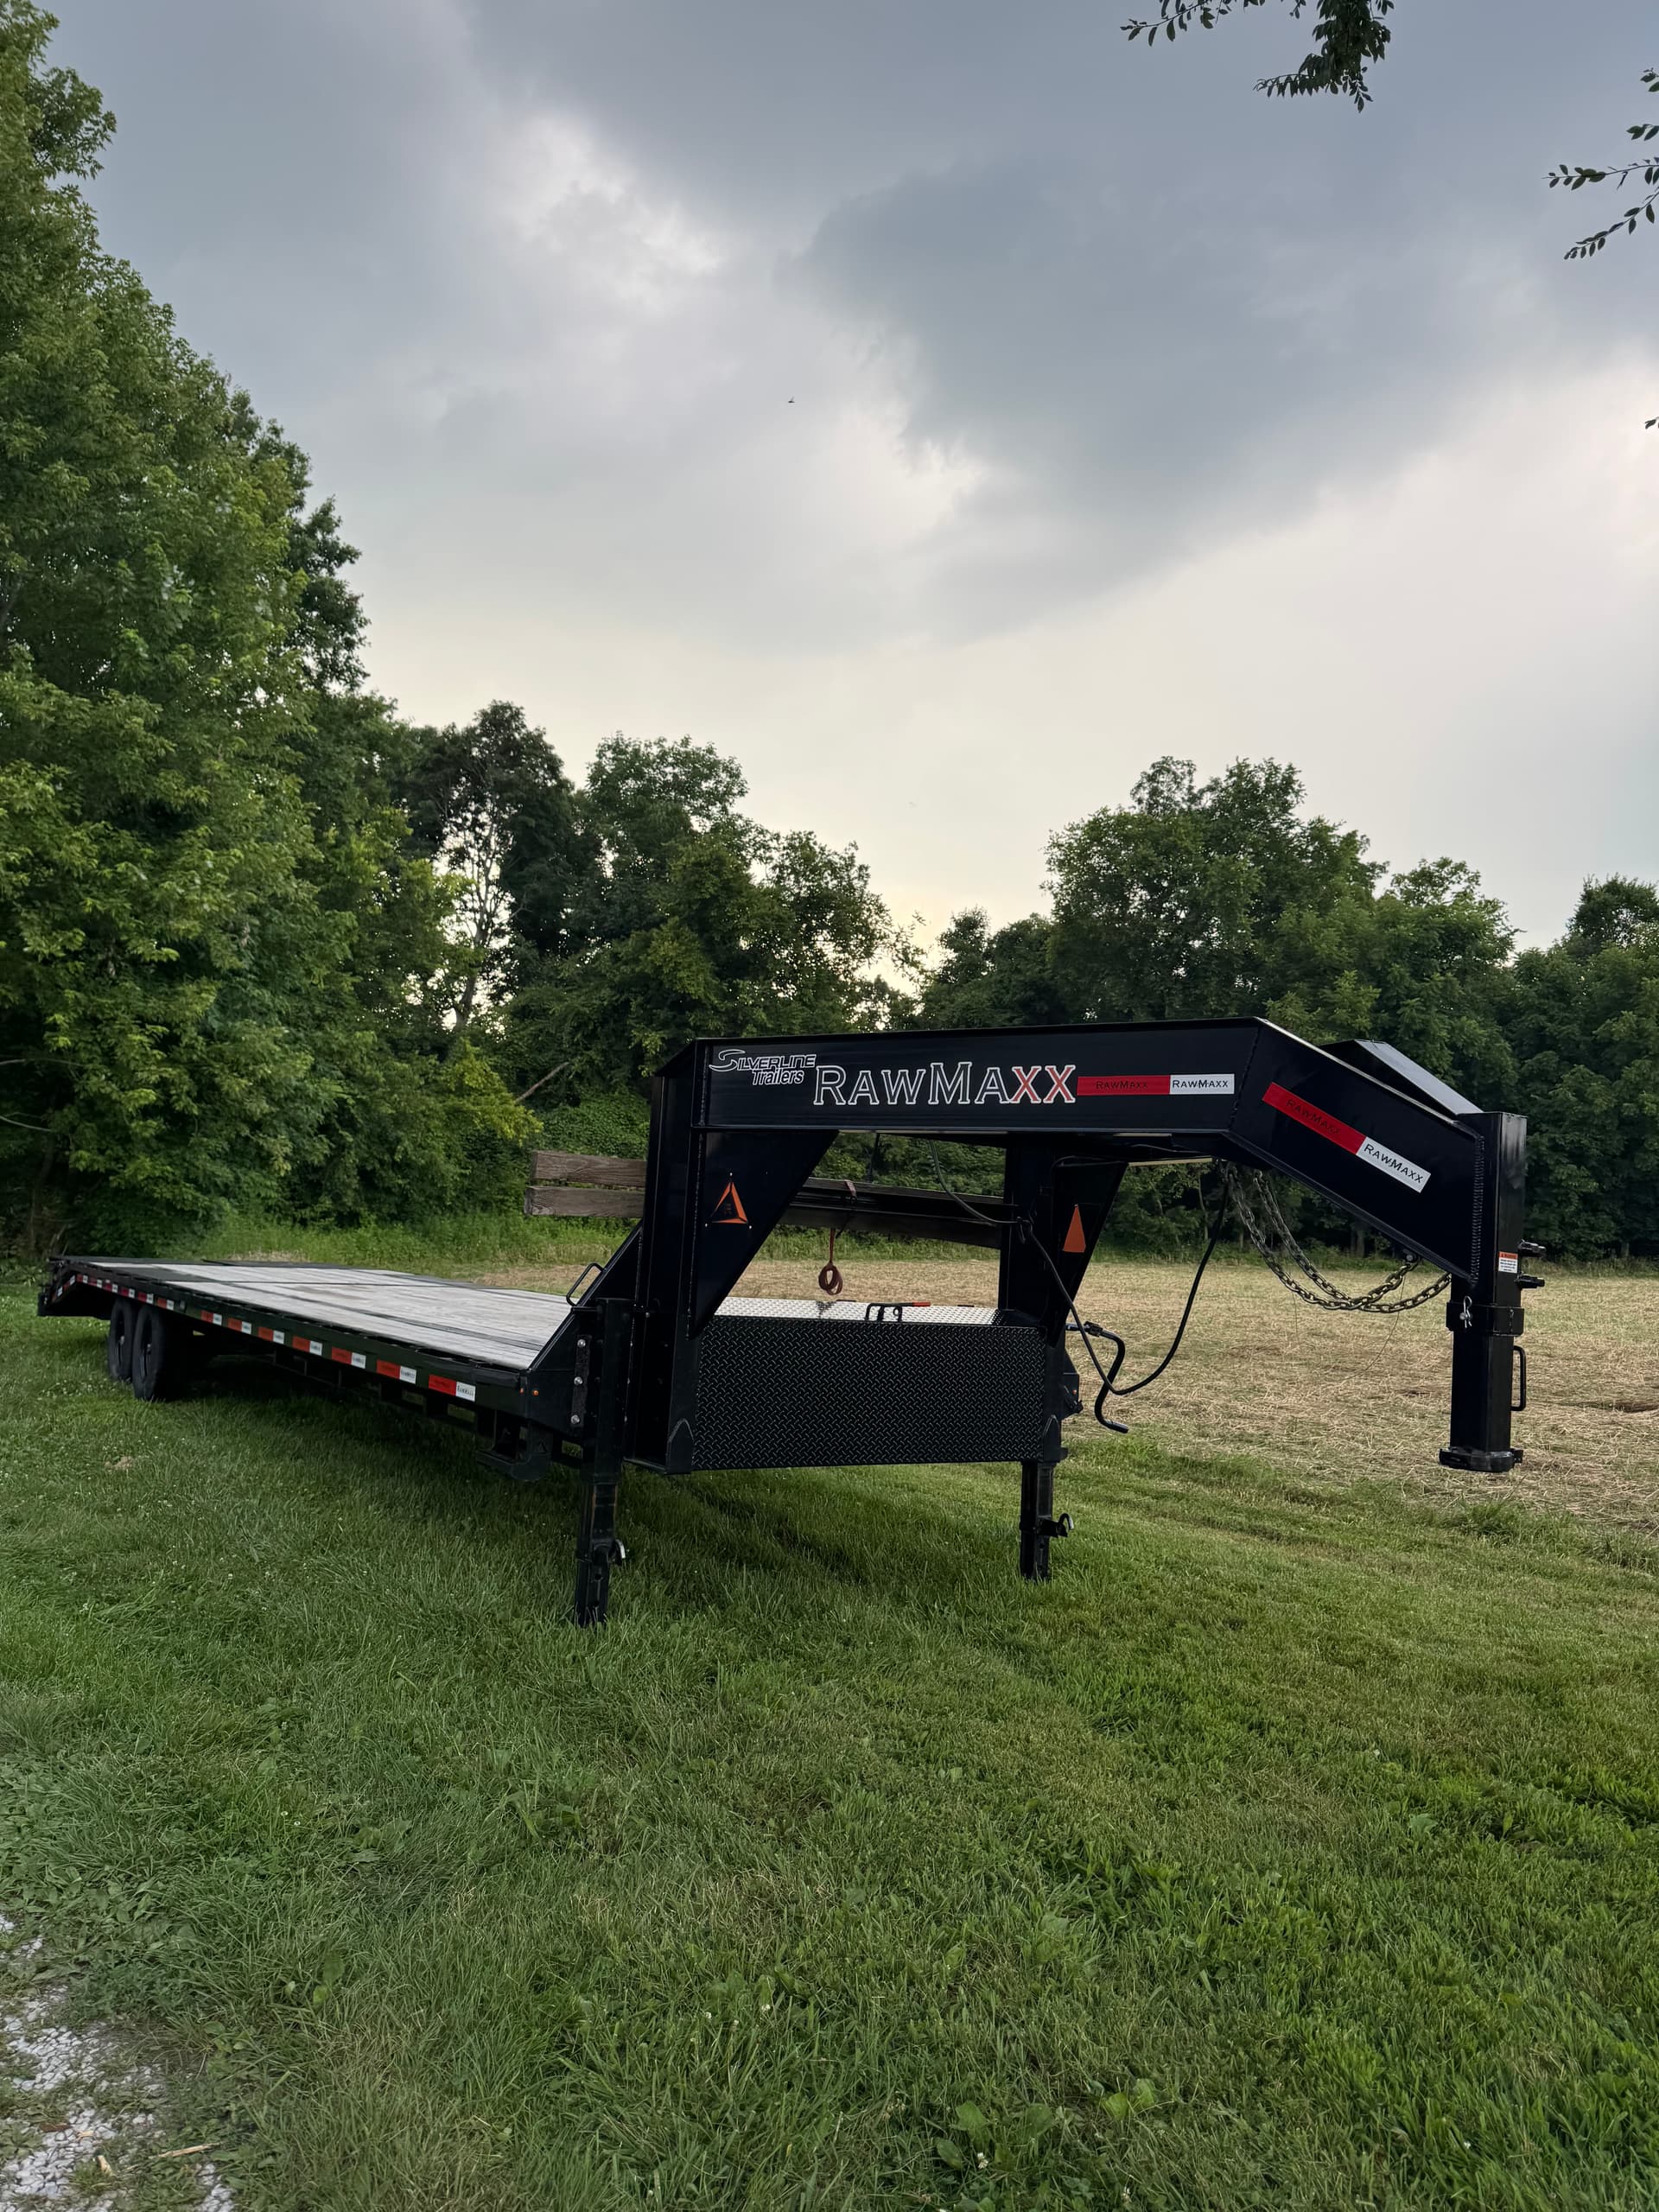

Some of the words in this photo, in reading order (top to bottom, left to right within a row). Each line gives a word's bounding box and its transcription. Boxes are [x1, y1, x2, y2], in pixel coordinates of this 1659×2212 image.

[709, 1048, 817, 1072] SILVERLINE
[752, 1068, 804, 1085] Trailers
[813, 1061, 1076, 1105] RAWMAXX
[1172, 1079, 1229, 1089] RAWMAXX
[1363, 1143, 1424, 1184] RAWMAXX
